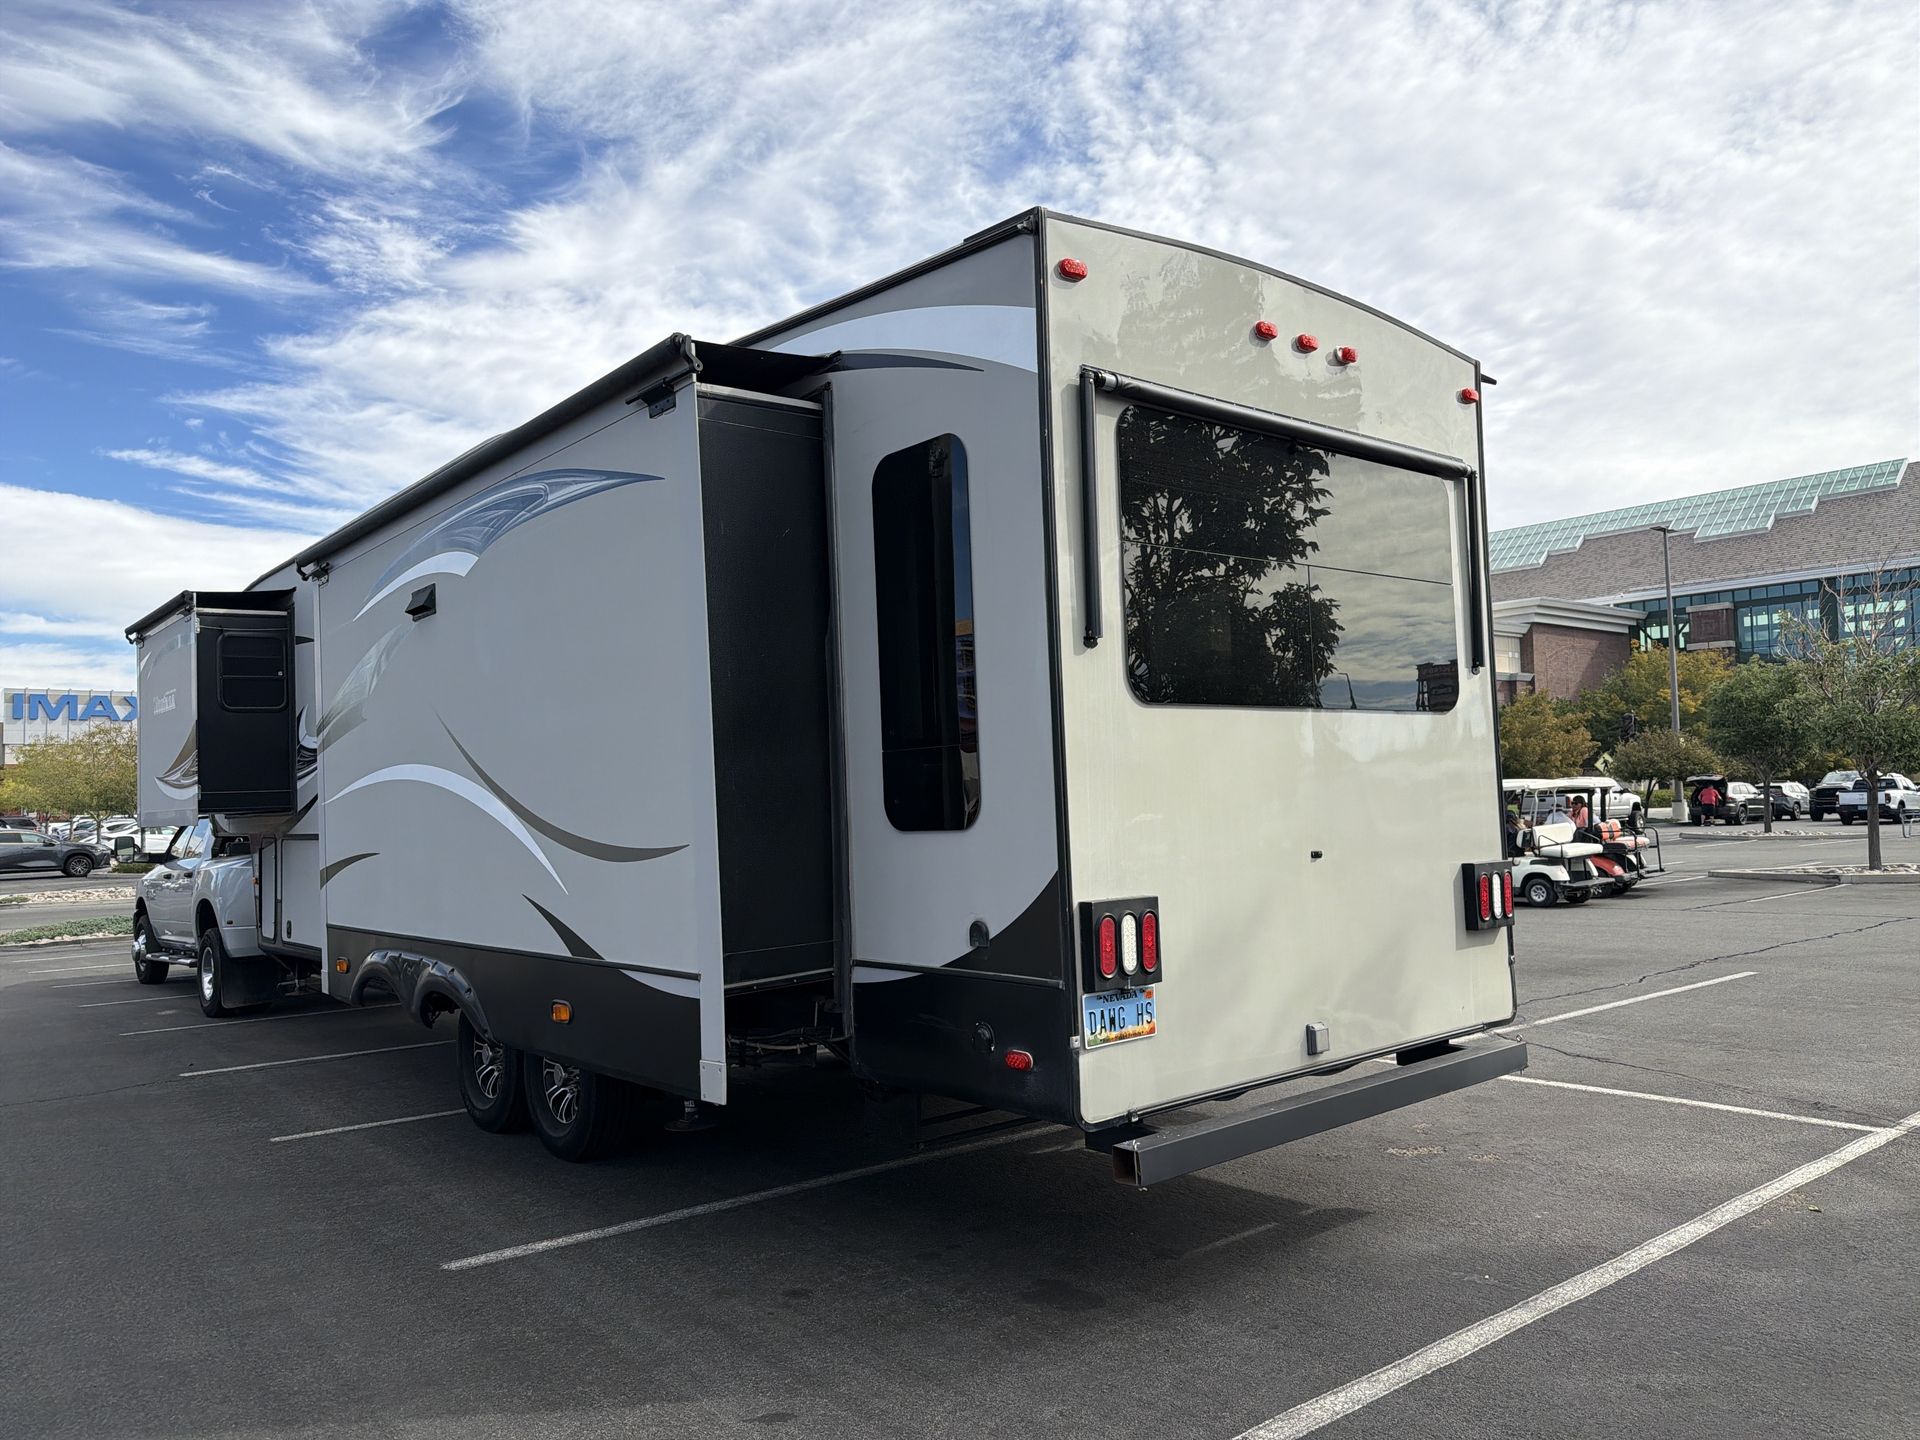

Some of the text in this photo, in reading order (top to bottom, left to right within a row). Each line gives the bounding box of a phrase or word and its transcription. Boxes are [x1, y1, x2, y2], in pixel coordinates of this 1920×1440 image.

[1103, 990, 1138, 1003] NEVADA
[1089, 1002, 1153, 1035] DAWG HS
